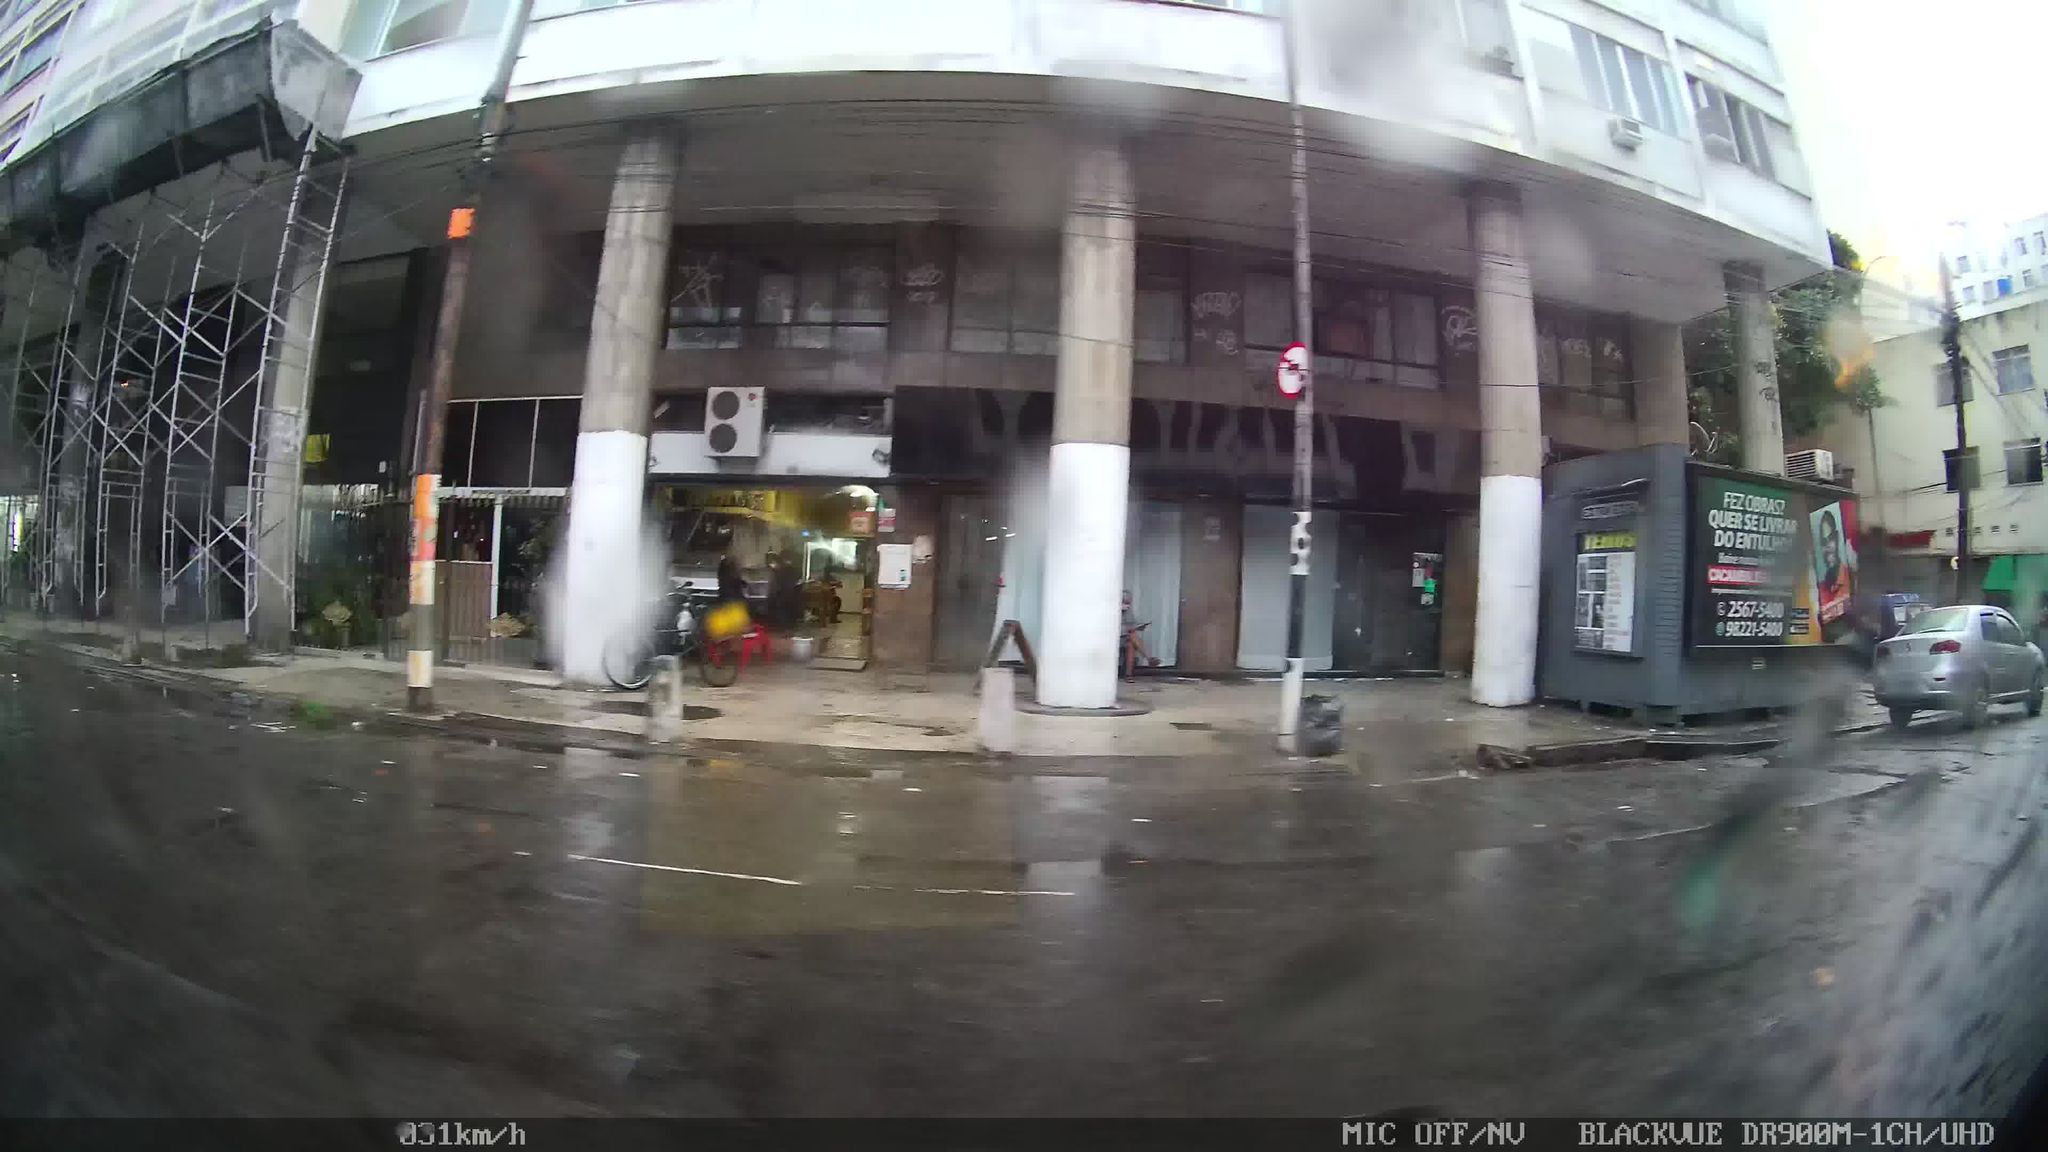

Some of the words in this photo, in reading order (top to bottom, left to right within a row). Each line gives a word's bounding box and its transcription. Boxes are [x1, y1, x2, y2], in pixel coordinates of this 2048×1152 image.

[1723, 491, 1745, 510] FEZ
[1745, 494, 1786, 515] OBRAS?
[1708, 509, 1742, 530] QUER
[1744, 513, 1758, 531] SE
[1713, 529, 1735, 548] DO
